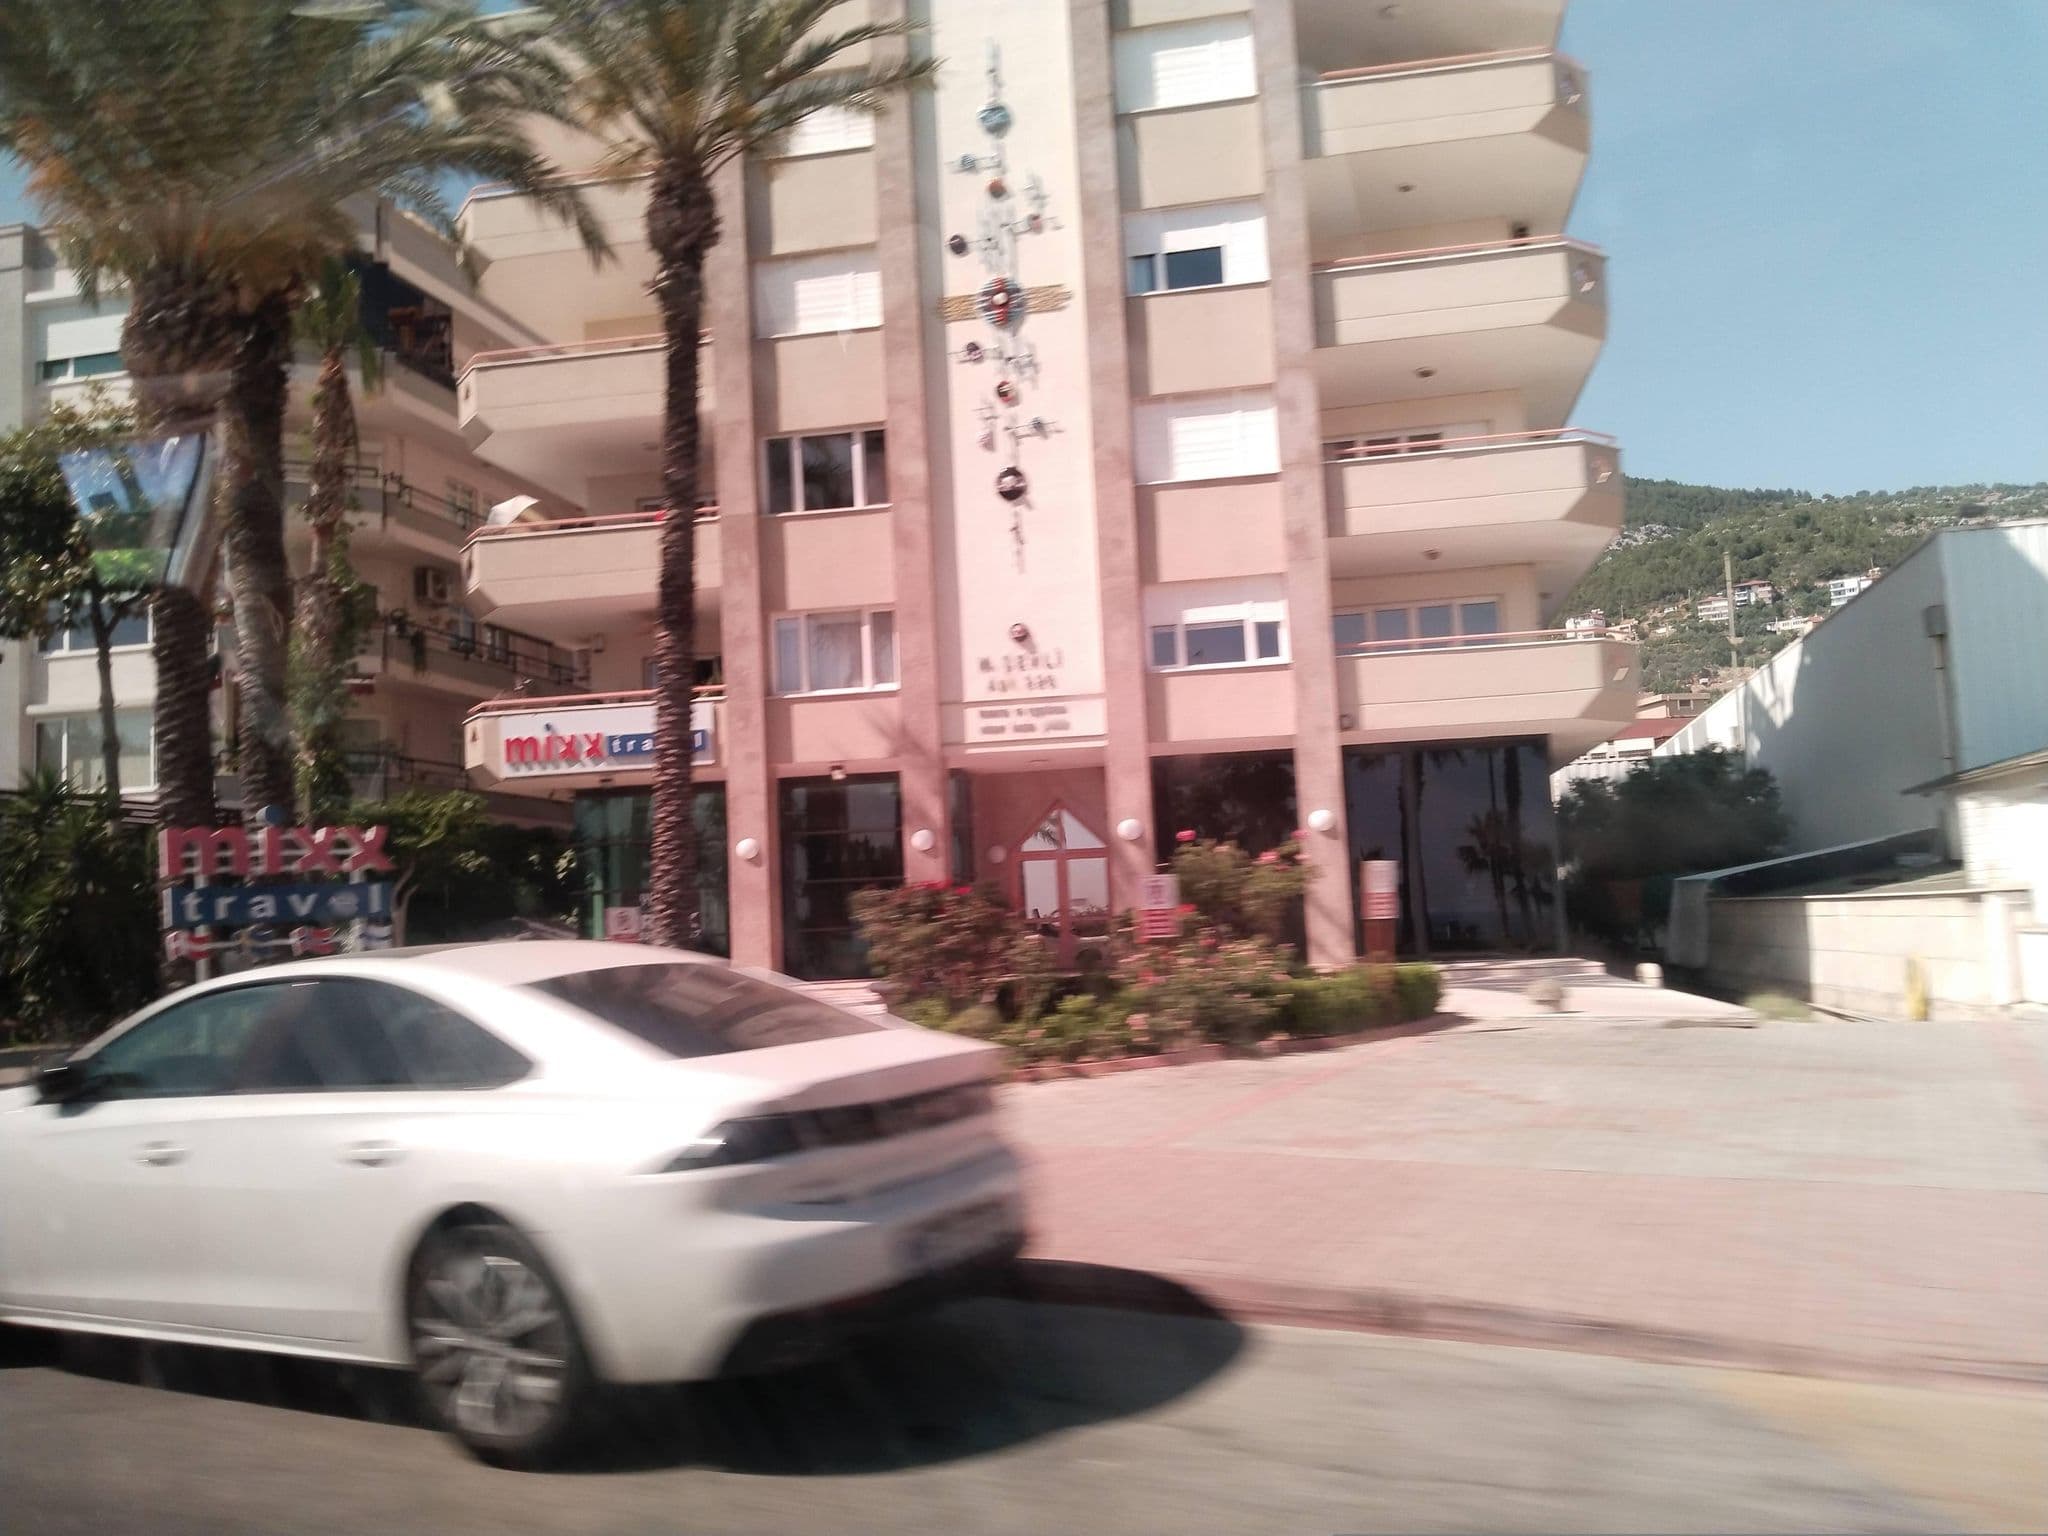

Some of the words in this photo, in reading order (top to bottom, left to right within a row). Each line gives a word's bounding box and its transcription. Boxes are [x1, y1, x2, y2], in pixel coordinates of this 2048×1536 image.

[504, 722, 604, 763] mixx
[611, 731, 703, 757] tral
[159, 805, 396, 878] mixx
[180, 882, 382, 921] travel
